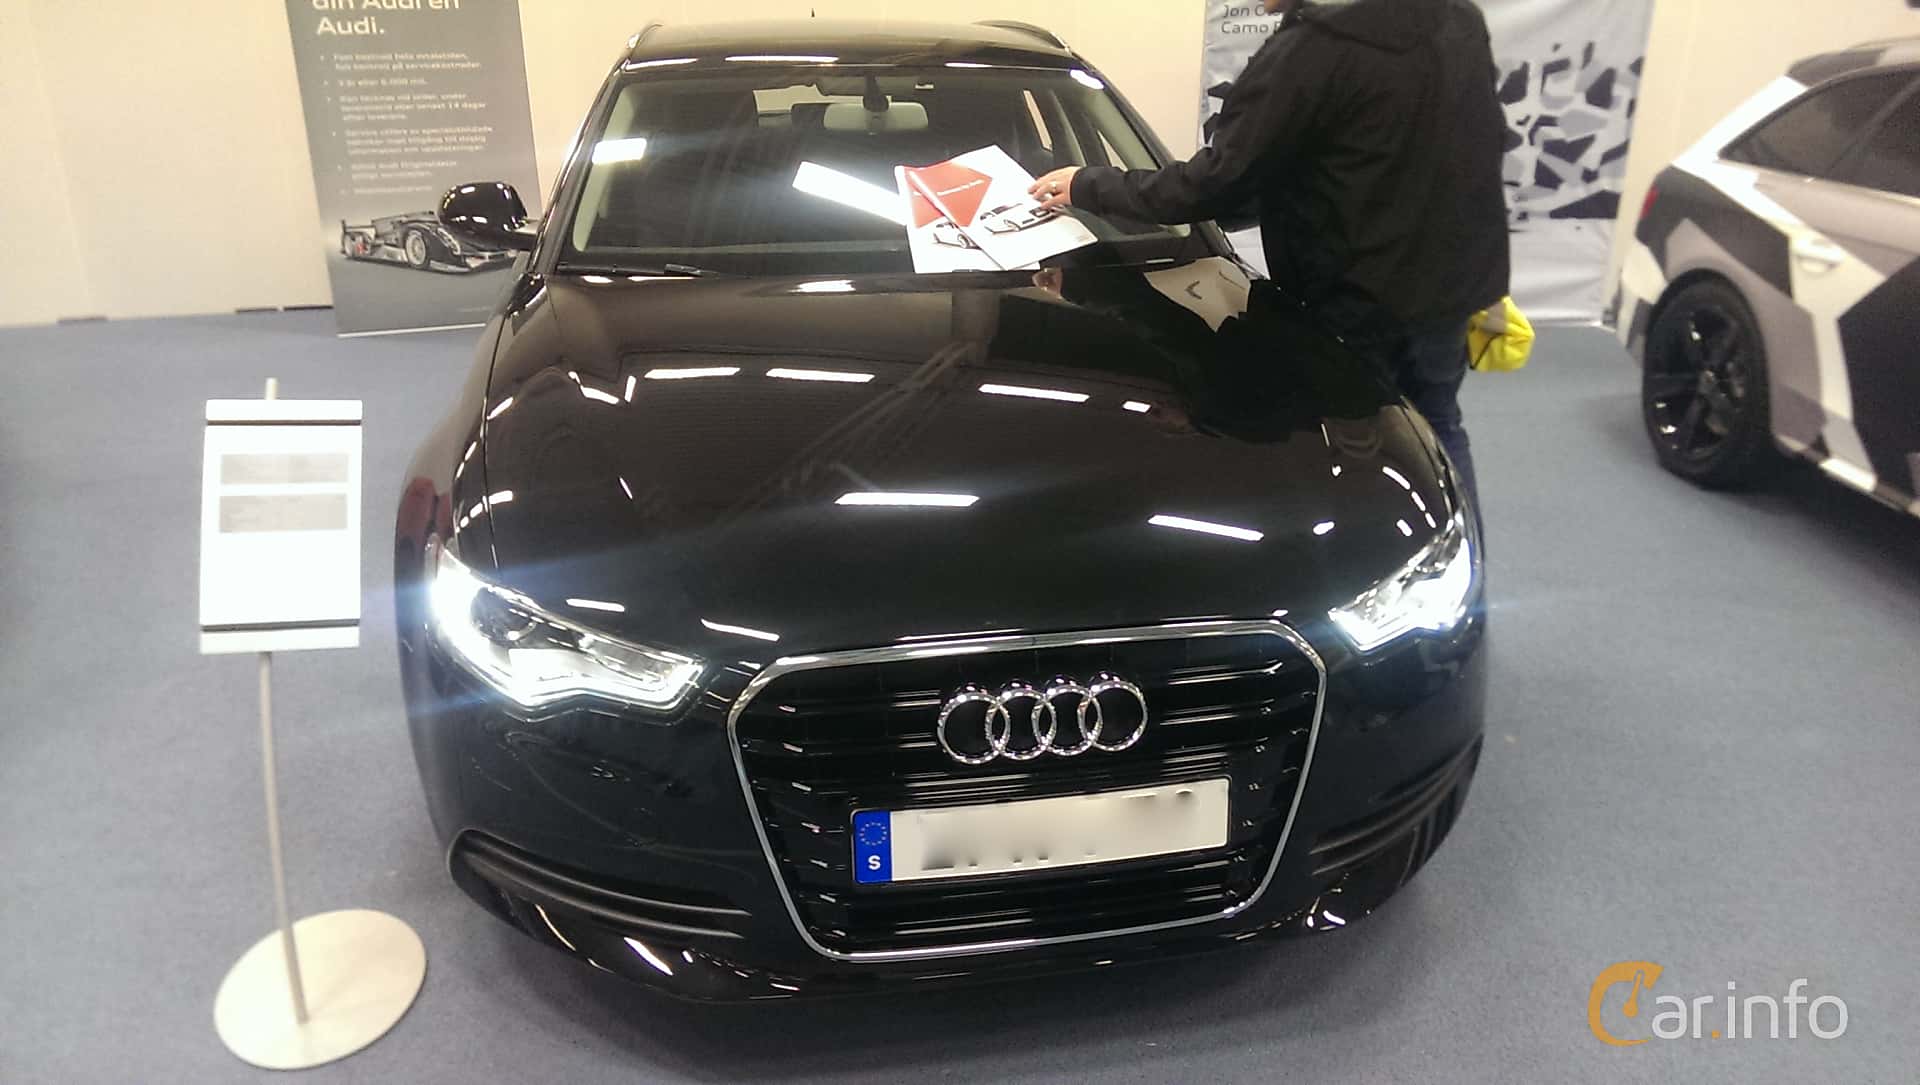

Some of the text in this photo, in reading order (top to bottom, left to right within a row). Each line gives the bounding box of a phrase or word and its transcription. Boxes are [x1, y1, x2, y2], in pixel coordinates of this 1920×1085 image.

[1223, 4, 1250, 18] Jon
[316, 16, 385, 35] Audi.
[1221, 21, 1269, 34] Camo
[868, 855, 881, 870] S
